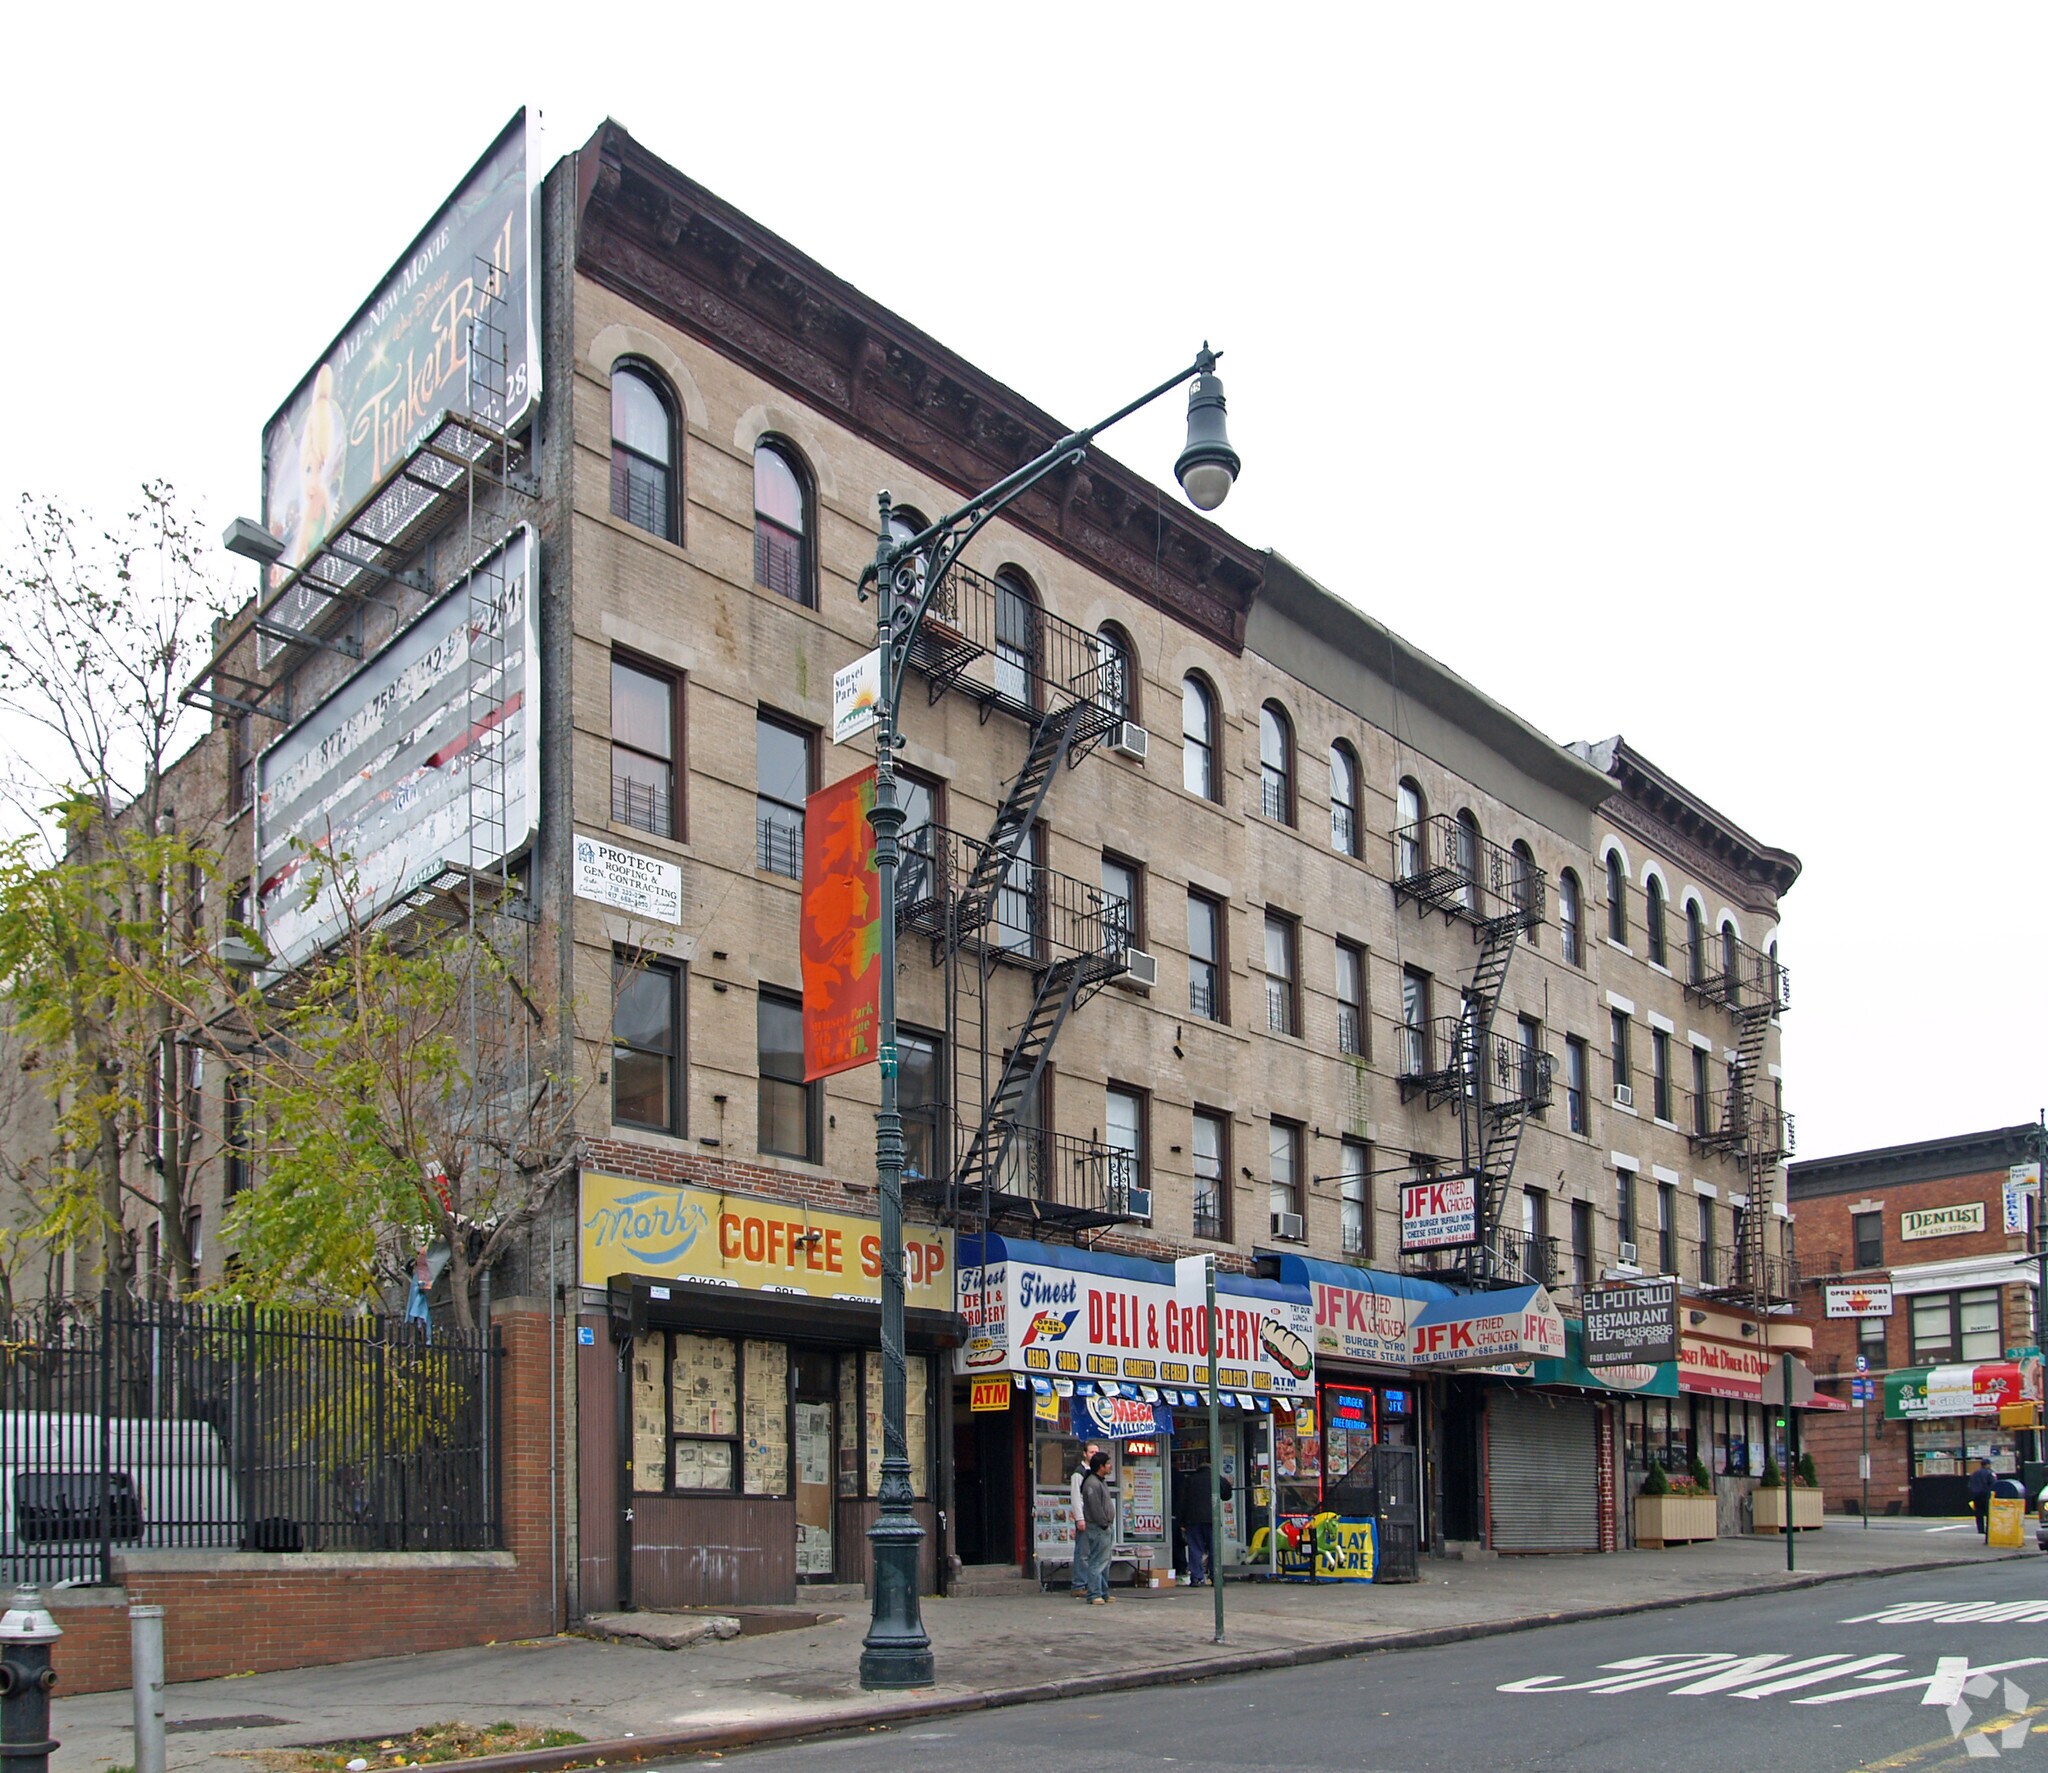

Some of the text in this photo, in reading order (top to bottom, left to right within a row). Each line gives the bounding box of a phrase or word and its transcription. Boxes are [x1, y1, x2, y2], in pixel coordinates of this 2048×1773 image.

[835, 664, 863, 690] Sunset
[835, 682, 858, 704] Park
[599, 846, 664, 876] PROTECT
[605, 861, 658, 885] ROOFING &
[584, 865, 677, 900] GEN. CONTRACTING
[1446, 1180, 1465, 1196] FRIED
[1404, 1184, 1447, 1219] JFK
[1447, 1196, 1475, 1213] CHICKEN
[1905, 1206, 1981, 1231] DENTIST
[1428, 1227, 1444, 1236] STEAK
[1914, 1229, 1927, 1237] 718
[719, 1213, 945, 1285] COFFEE SOP
[1404, 1240, 1416, 1248] FREE
[1418, 1237, 1442, 1246] DELIVERY
[995, 1289, 1003, 1302] &
[1020, 1270, 1077, 1308] Finest
[1365, 1295, 1391, 1315] FRIED
[1583, 1286, 1672, 1311] EL POTRILLO
[1290, 1304, 1299, 1313] TRY
[1301, 1306, 1311, 1314] OUR
[1315, 1284, 1367, 1332] JFK
[1088, 1289, 1261, 1362] DELI & GROCERY
[1293, 1314, 1308, 1322] LUNCH
[1476, 1317, 1504, 1331] FRIED
[1546, 1318, 1557, 1330] FRIED
[1588, 1308, 1668, 1329] RESTAURANT
[1290, 1323, 1312, 1333] SPECIALS
[1368, 1316, 1406, 1339] CHICKEN
[1523, 1313, 1548, 1343] JFK
[1413, 1320, 1475, 1354] JFK
[1477, 1329, 1518, 1346] CHICKEN
[1548, 1331, 1564, 1346] CHICKEN
[1624, 1335, 1669, 1347] LUNCH DINNER
[1027, 1348, 1048, 1369] HEROS
[1058, 1351, 1079, 1372] SODAS
[1380, 1352, 1406, 1362] STEAK
[1412, 1342, 1519, 1363] FREE DELIVERY 686-8488
[1590, 1352, 1632, 1362] FREE DELIVERY
[2012, 1348, 2025, 1358] 39
[1088, 1355, 1117, 1375] HOT COFFEE
[1126, 1358, 1155, 1379] CIGARETTES
[1743, 1353, 1750, 1373] &
[1171, 1364, 1187, 1382] CREAM
[1195, 1366, 1209, 1384] CAND
[1220, 1369, 1246, 1387] COLD CUTS
[1254, 1372, 1271, 1390] BAGELS
[1273, 1376, 1296, 1387] ATM
[1610, 1365, 1651, 1380] POTRILLO
[972, 1383, 1008, 1405] ATM
[1339, 1395, 1364, 1409] BURGER
[1899, 1393, 2000, 1410] DELI GROCERY
[1112, 1398, 1153, 1423] MEGA
[1388, 1401, 1403, 1412] JFK
[1111, 1422, 1155, 1438] MILLIONS
[1128, 1441, 1155, 1454] ATM
[1134, 1515, 1161, 1529] LOTTO
